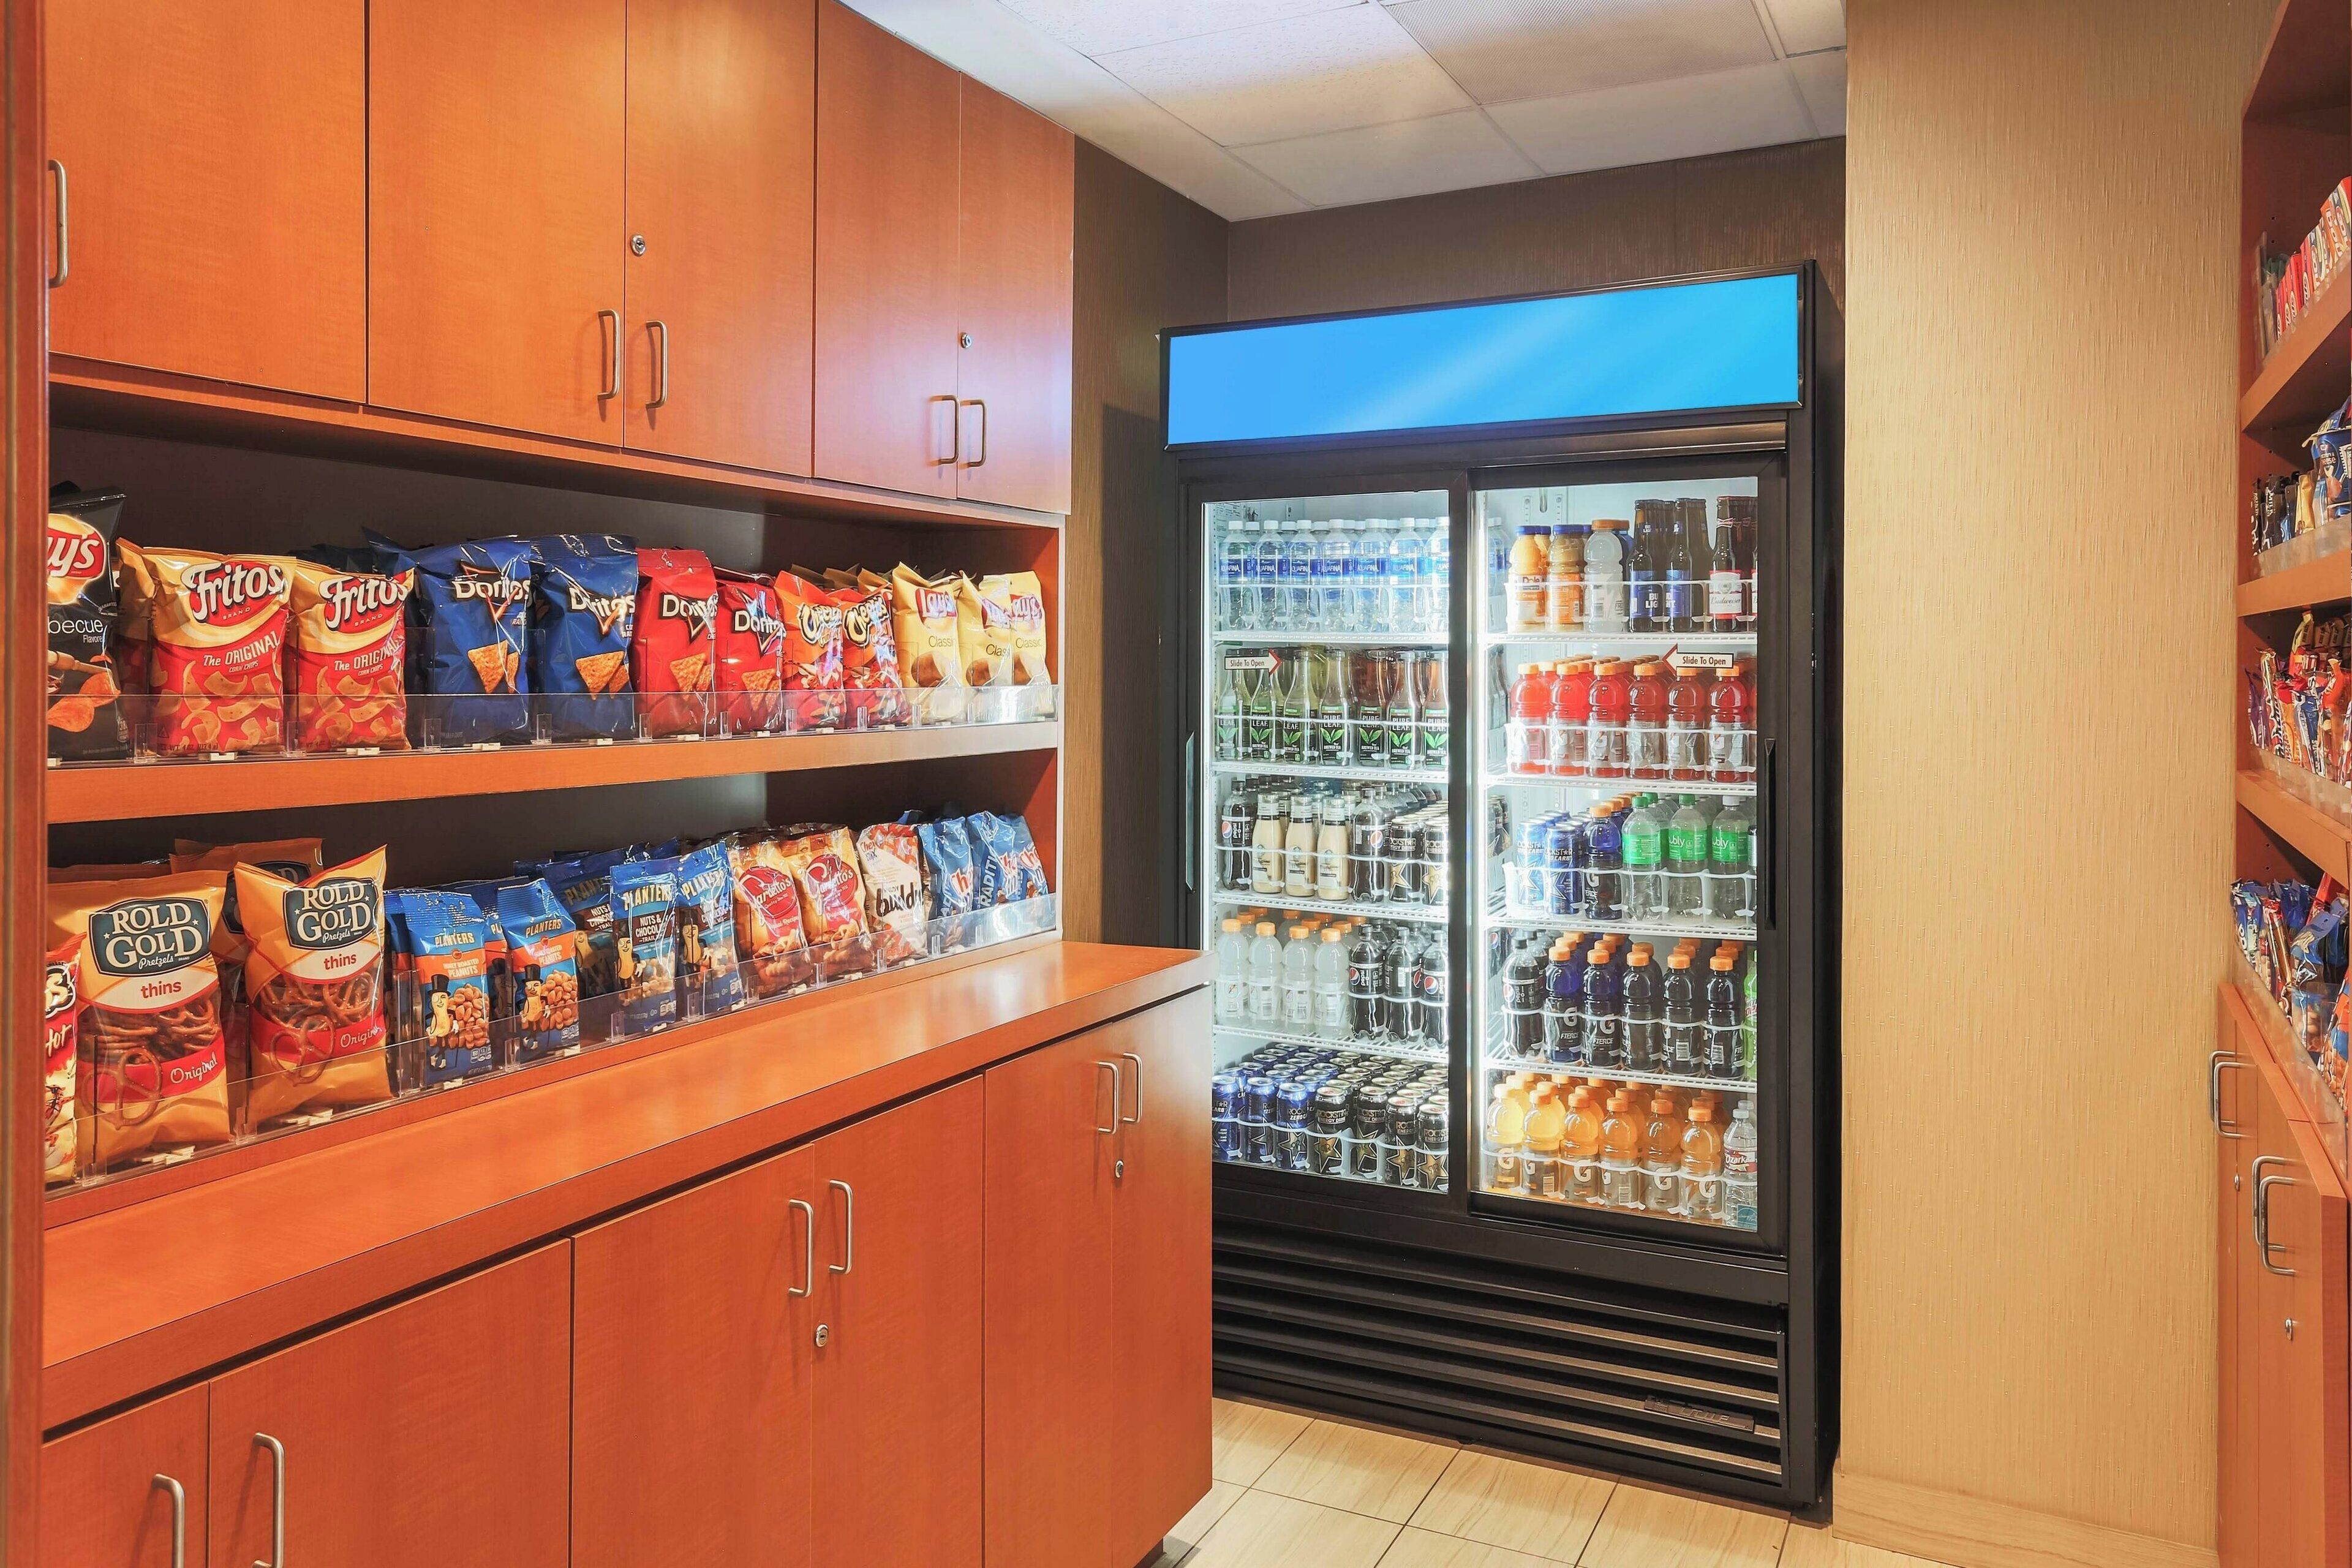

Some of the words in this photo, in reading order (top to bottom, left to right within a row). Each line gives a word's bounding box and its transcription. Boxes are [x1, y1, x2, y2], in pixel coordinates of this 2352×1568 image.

[181, 562, 284, 621] Fritos
[319, 576, 409, 628] Fritos
[1711, 596, 1741, 606] Budweiser
[223, 607, 251, 620] BRAND
[355, 614, 383, 627] BRAND
[203, 655, 221, 666] The
[225, 630, 281, 665] ORIGINAL
[334, 660, 350, 671] The
[353, 636, 400, 669] ORIGINAL
[229, 665, 243, 673] CORN
[244, 661, 259, 670] CHIPS
[370, 664, 384, 674] CHIPS
[1251, 659, 1265, 668] Open
[1683, 656, 1698, 665] Slide
[1708, 657, 1726, 666] Open
[301, 881, 365, 911] ROLD
[111, 902, 192, 935] ROLD
[590, 906, 607, 917] NUTS
[296, 902, 371, 942] GOLD
[526, 918, 563, 938] PLANTERS
[639, 916, 655, 926] NUTS
[322, 928, 351, 943] Pretzels
[434, 932, 475, 948] PLANTERS
[105, 925, 203, 968] GOLD
[138, 953, 175, 970] Pretzels
[323, 953, 356, 971] thins
[447, 966, 478, 978] PEANUTS
[141, 981, 182, 999] thins
[170, 1052, 217, 1084] Original
[1574, 1159, 1591, 1183] G
[1654, 1167, 1672, 1191] G
